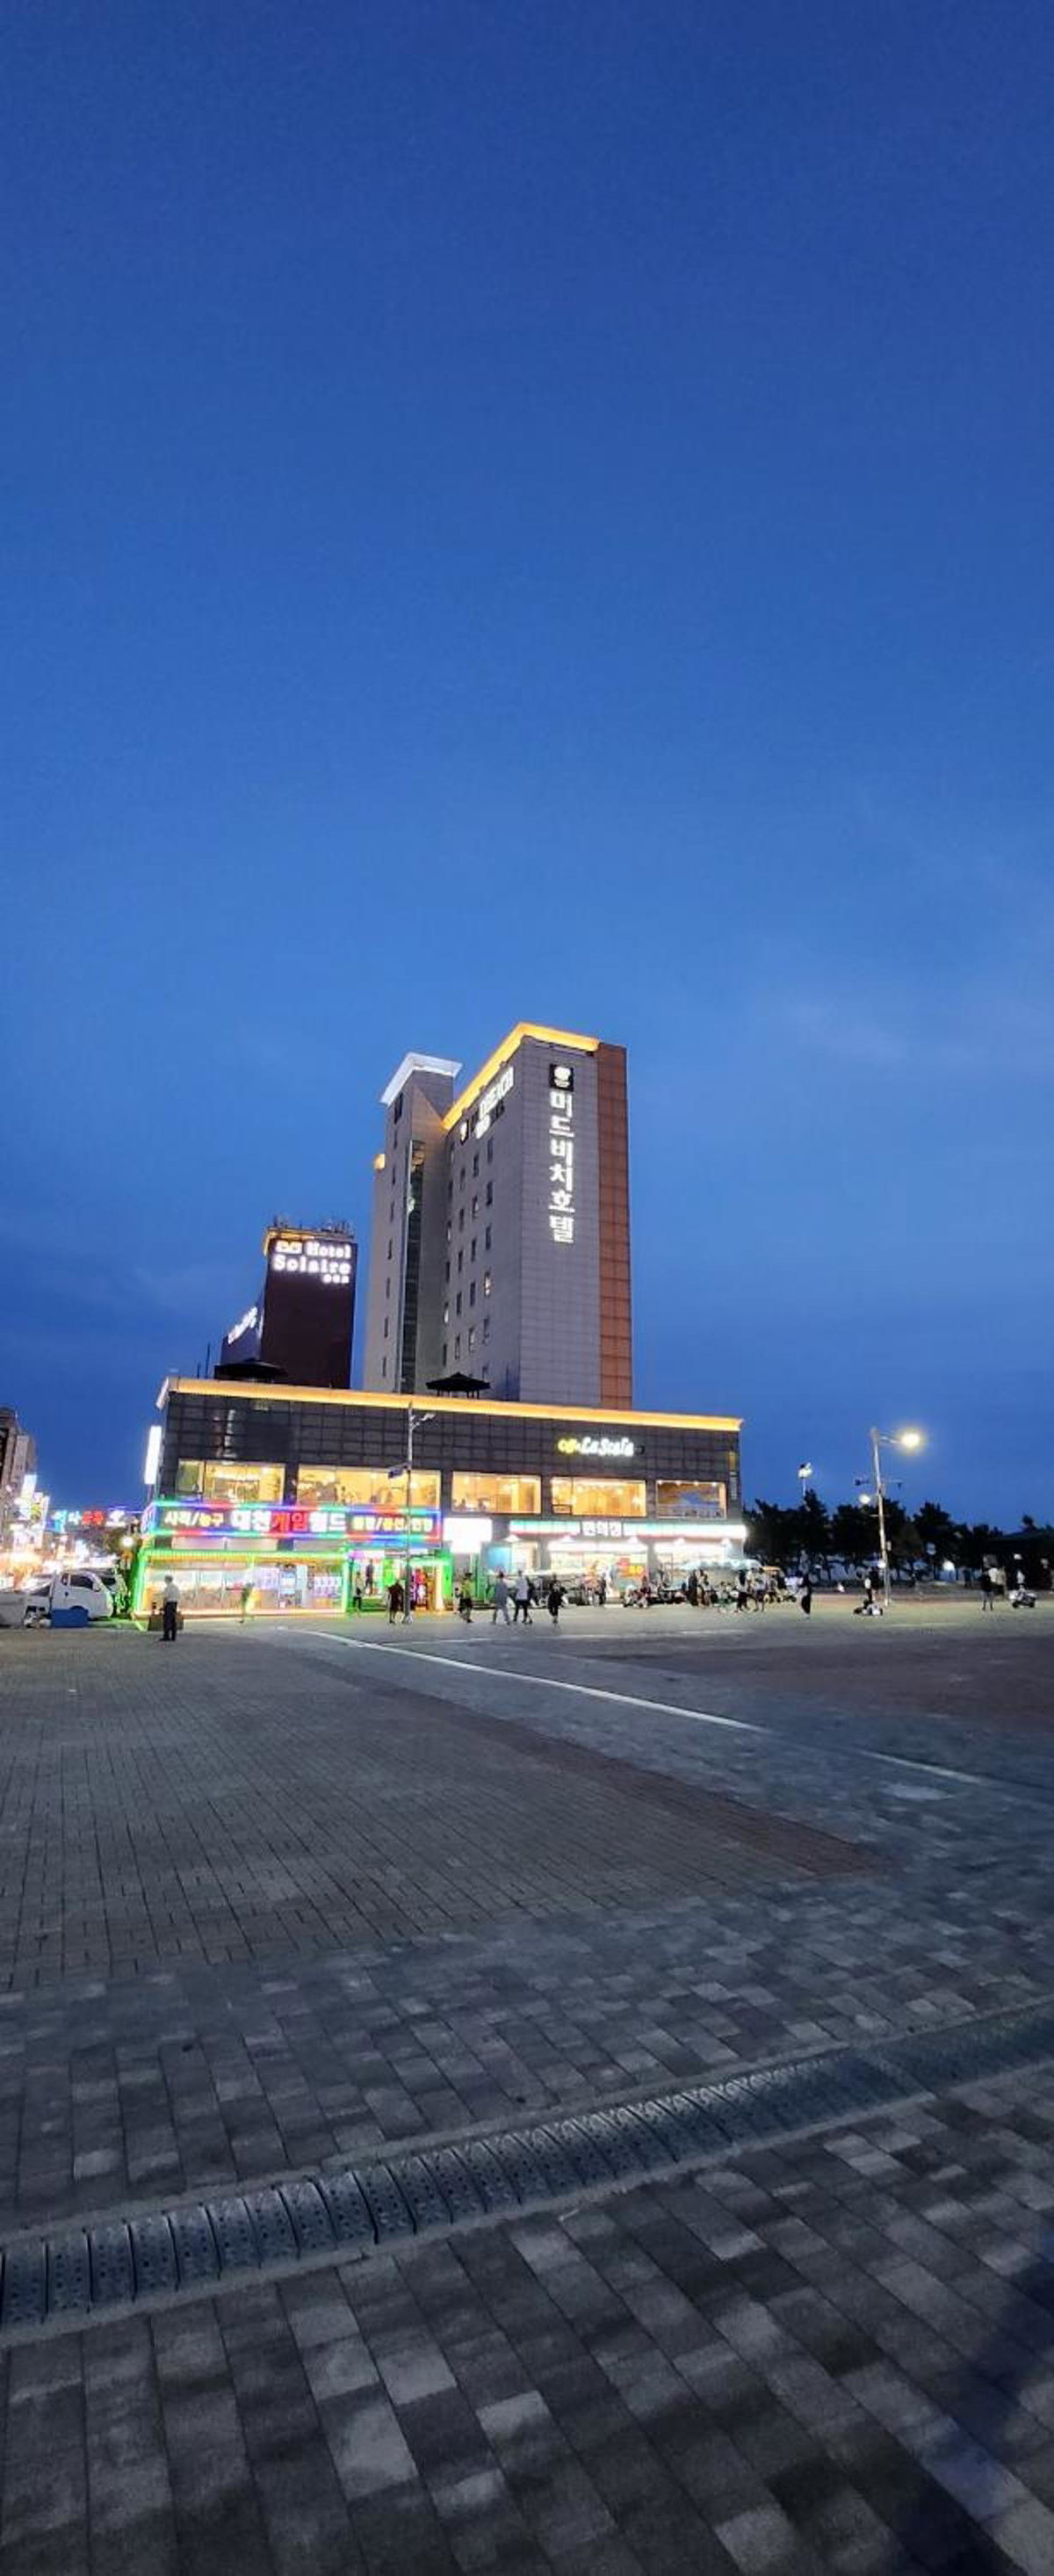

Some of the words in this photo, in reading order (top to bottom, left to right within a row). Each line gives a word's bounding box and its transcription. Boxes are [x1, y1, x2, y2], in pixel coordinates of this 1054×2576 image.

[548, 1090, 575, 1243] 머드비치호텔
[306, 1241, 351, 1259] Hotel
[273, 1254, 351, 1275] Solaire
